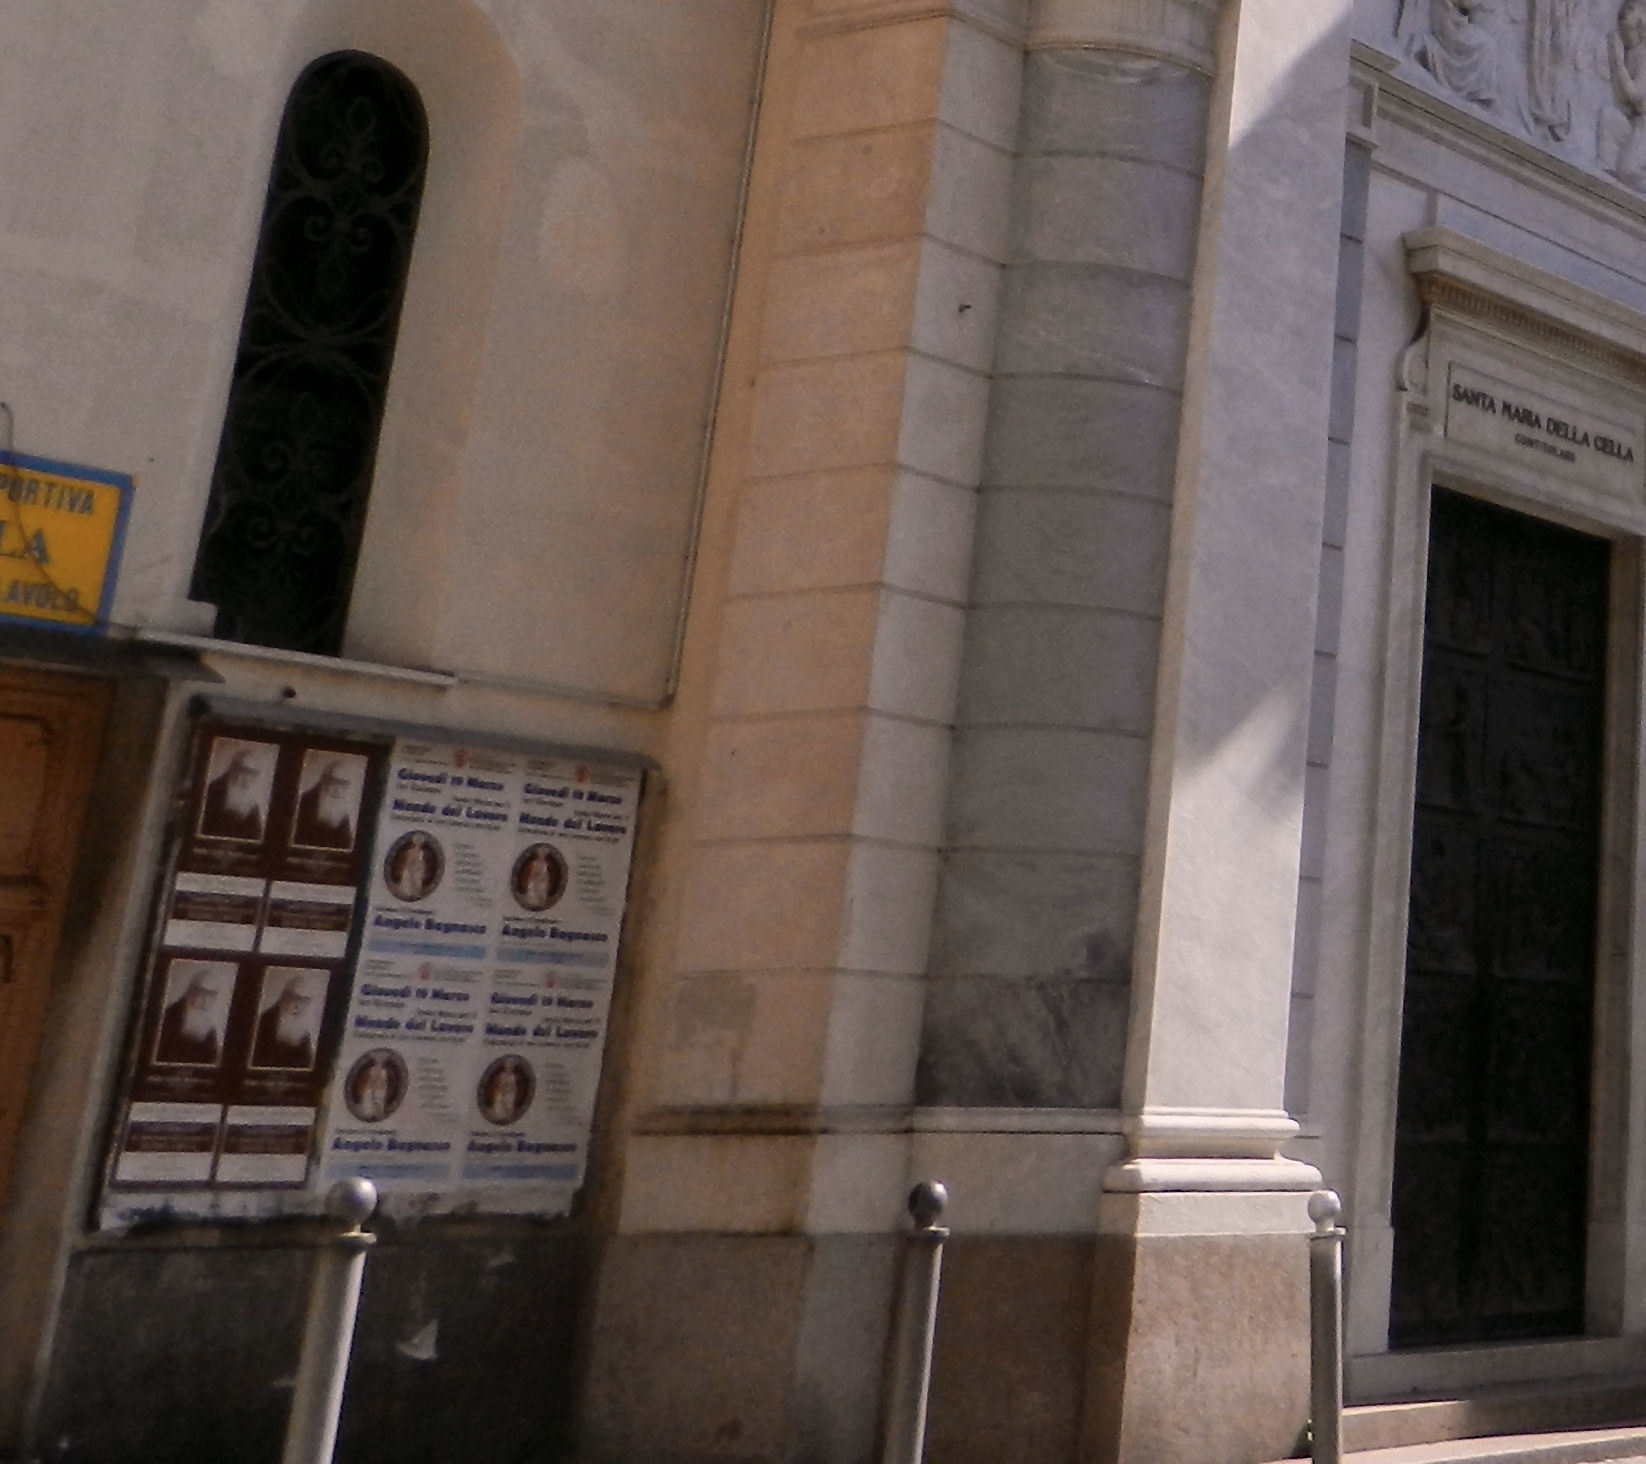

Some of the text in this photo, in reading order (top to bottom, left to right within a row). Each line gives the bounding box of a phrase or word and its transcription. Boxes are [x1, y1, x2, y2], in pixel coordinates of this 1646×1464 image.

[1452, 383, 1634, 462] SANTA MARIA DELLA CELLA
